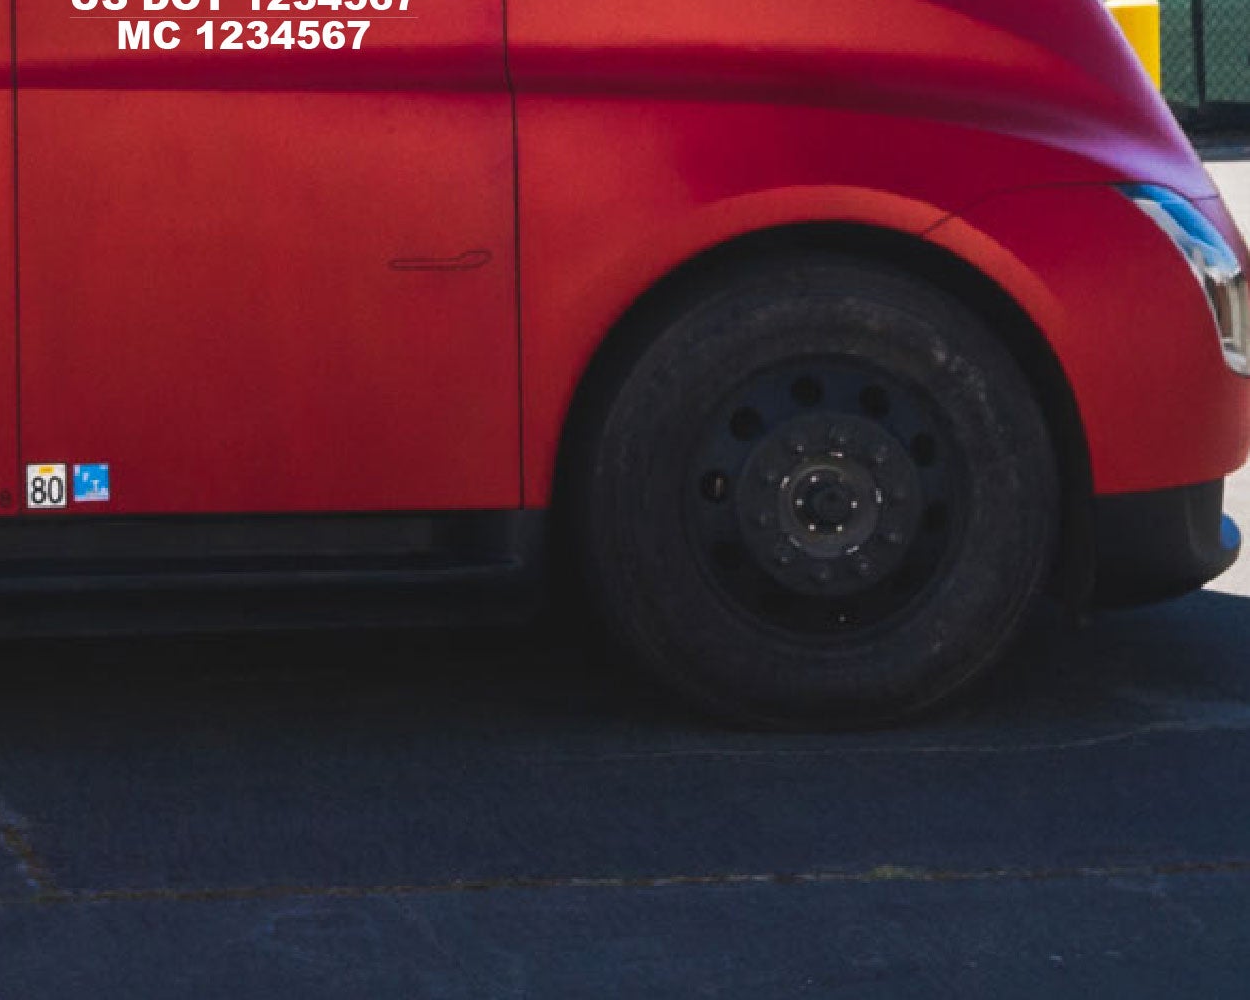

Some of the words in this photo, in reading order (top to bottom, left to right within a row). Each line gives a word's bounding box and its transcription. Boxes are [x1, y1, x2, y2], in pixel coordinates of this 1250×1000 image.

[118, 20, 181, 50] MC
[196, 20, 371, 50] 1234567
[31, 475, 64, 504] 80
